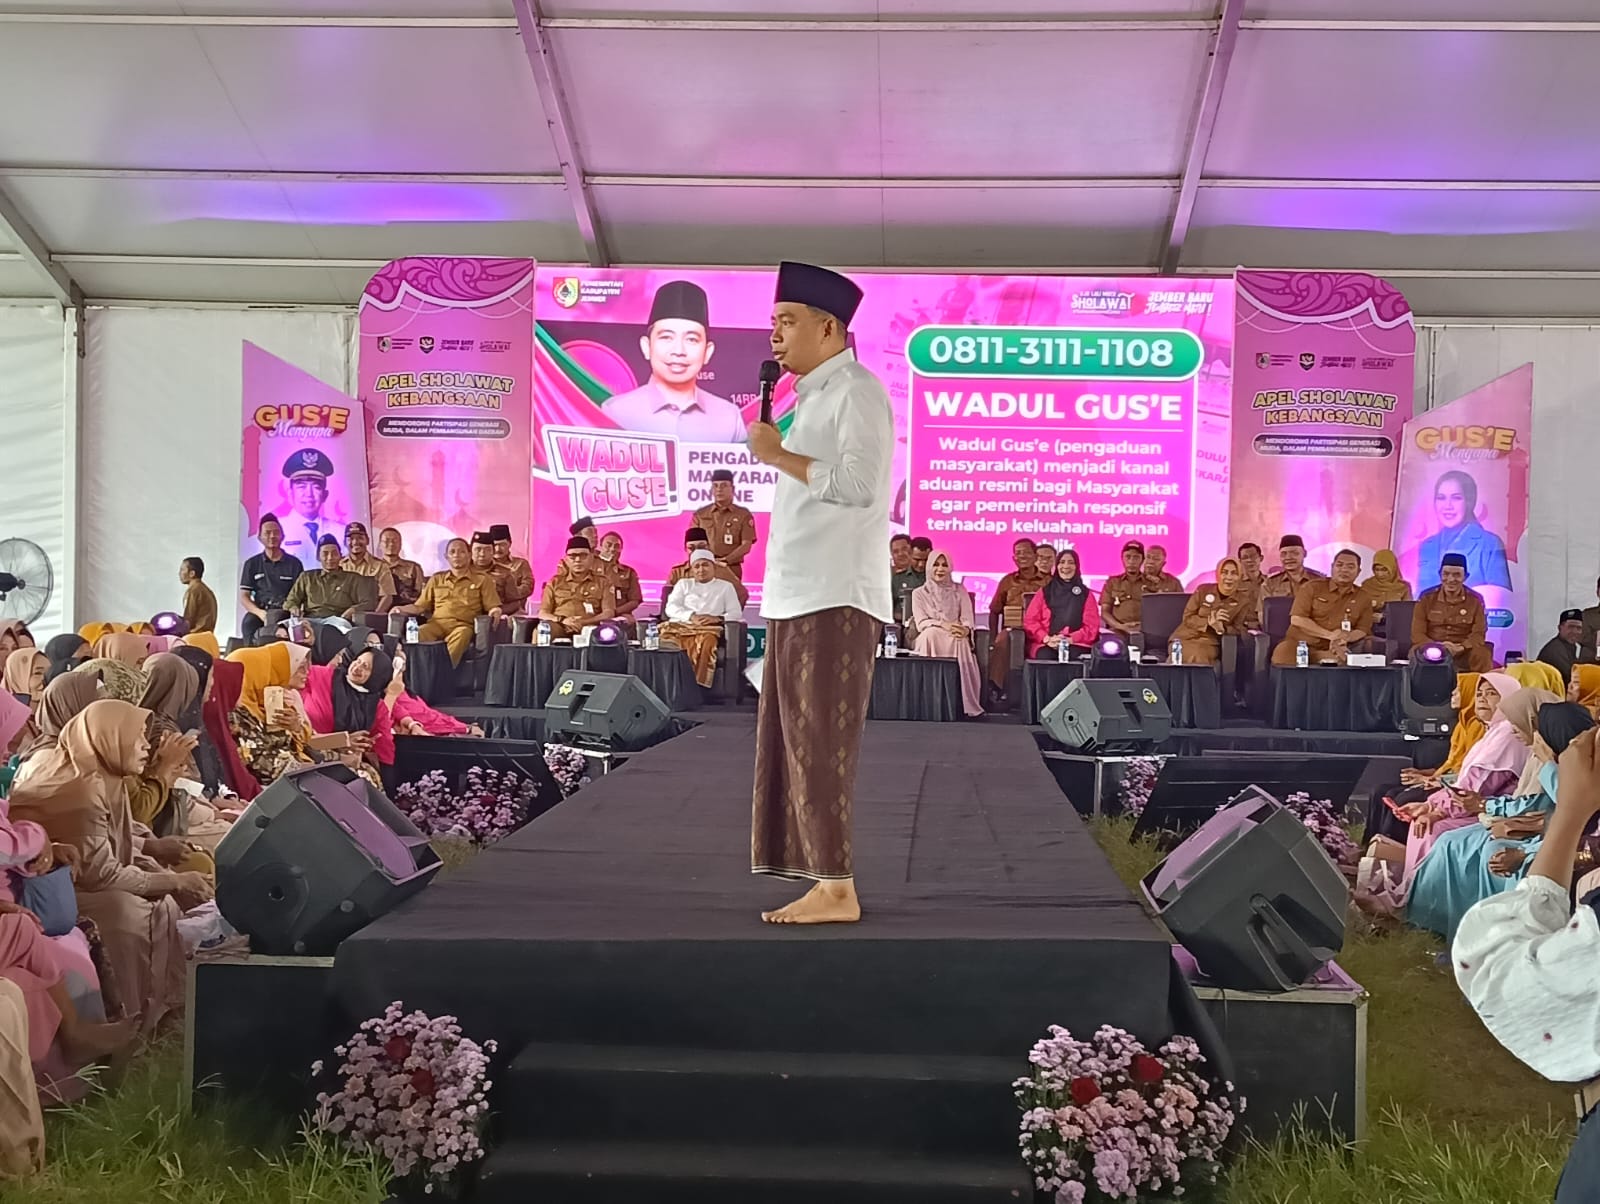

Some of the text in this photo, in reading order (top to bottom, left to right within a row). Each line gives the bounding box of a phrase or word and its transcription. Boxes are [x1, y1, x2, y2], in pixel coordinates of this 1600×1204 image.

[929, 336, 1174, 367] 0811-3111-1108
[376, 372, 514, 393] APEL SHOLAWAT
[387, 391, 501, 409] KEBANGSAAN
[924, 391, 1182, 421] WADUL GUS'E
[1253, 390, 1396, 411] APEL SHOLAWAT
[254, 404, 350, 433] GUS'E
[1265, 409, 1383, 427] KEBANGSAAN
[939, 437, 996, 452] Wadul
[1054, 438, 1162, 457] (pengaduan
[1415, 425, 1516, 455] GUS'E
[556, 436, 665, 473] WADUL
[688, 451, 760, 465] PENGAD
[688, 470, 779, 485] MAYARA
[929, 458, 1170, 477] masyarakat) menjadi kanal
[687, 488, 754, 502] ONNE
[919, 477, 1179, 498] aduan resmi bagi Masyarakat
[931, 499, 1167, 518] agar pemerintah responsif
[927, 518, 1169, 538] terhadap keluahan layanan
